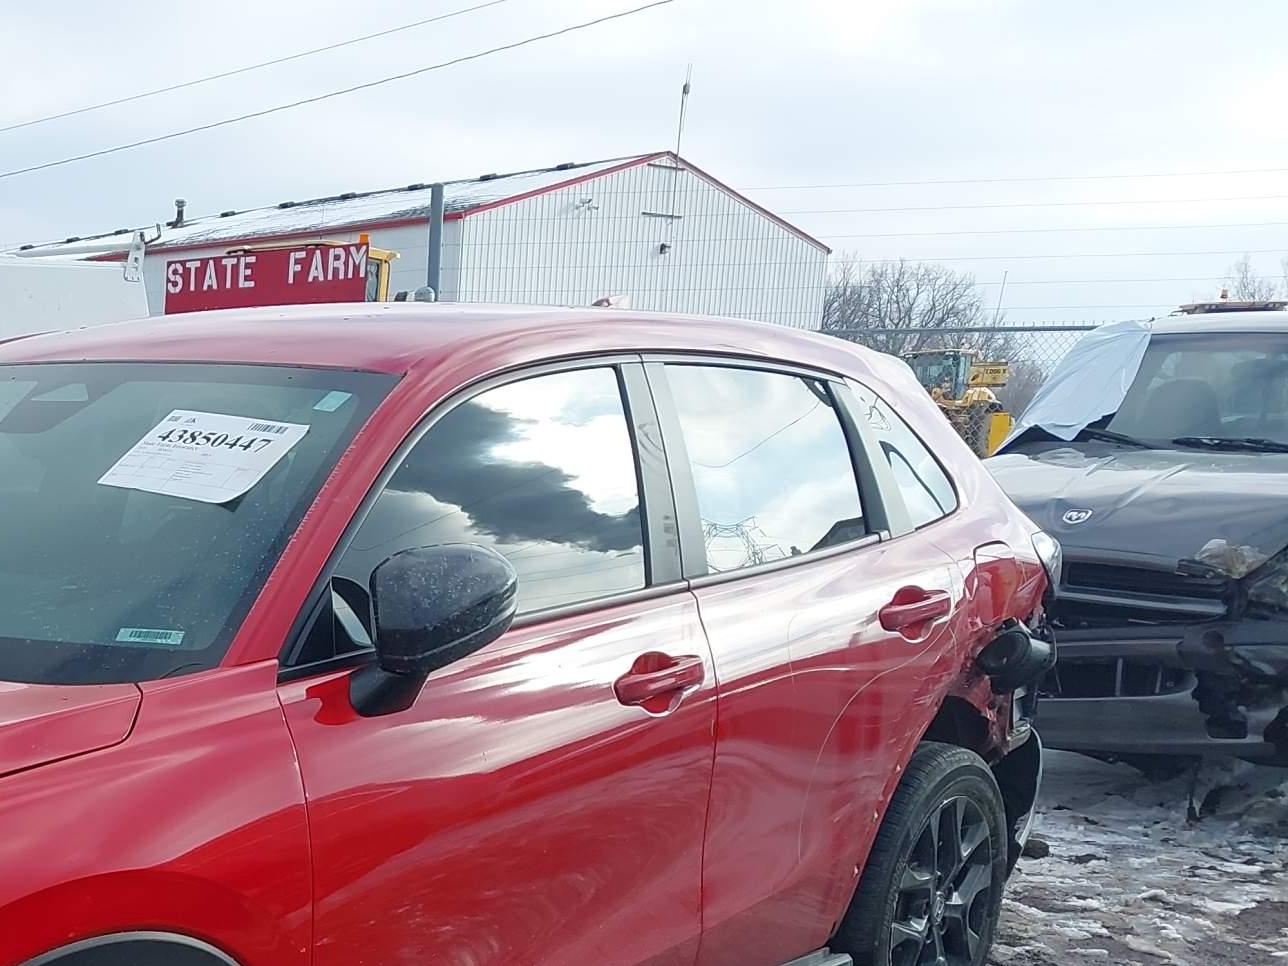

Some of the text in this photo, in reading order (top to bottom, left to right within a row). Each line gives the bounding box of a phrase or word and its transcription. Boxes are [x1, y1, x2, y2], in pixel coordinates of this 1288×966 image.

[167, 245, 367, 294] STATE FARM
[158, 427, 272, 454] 43850447
